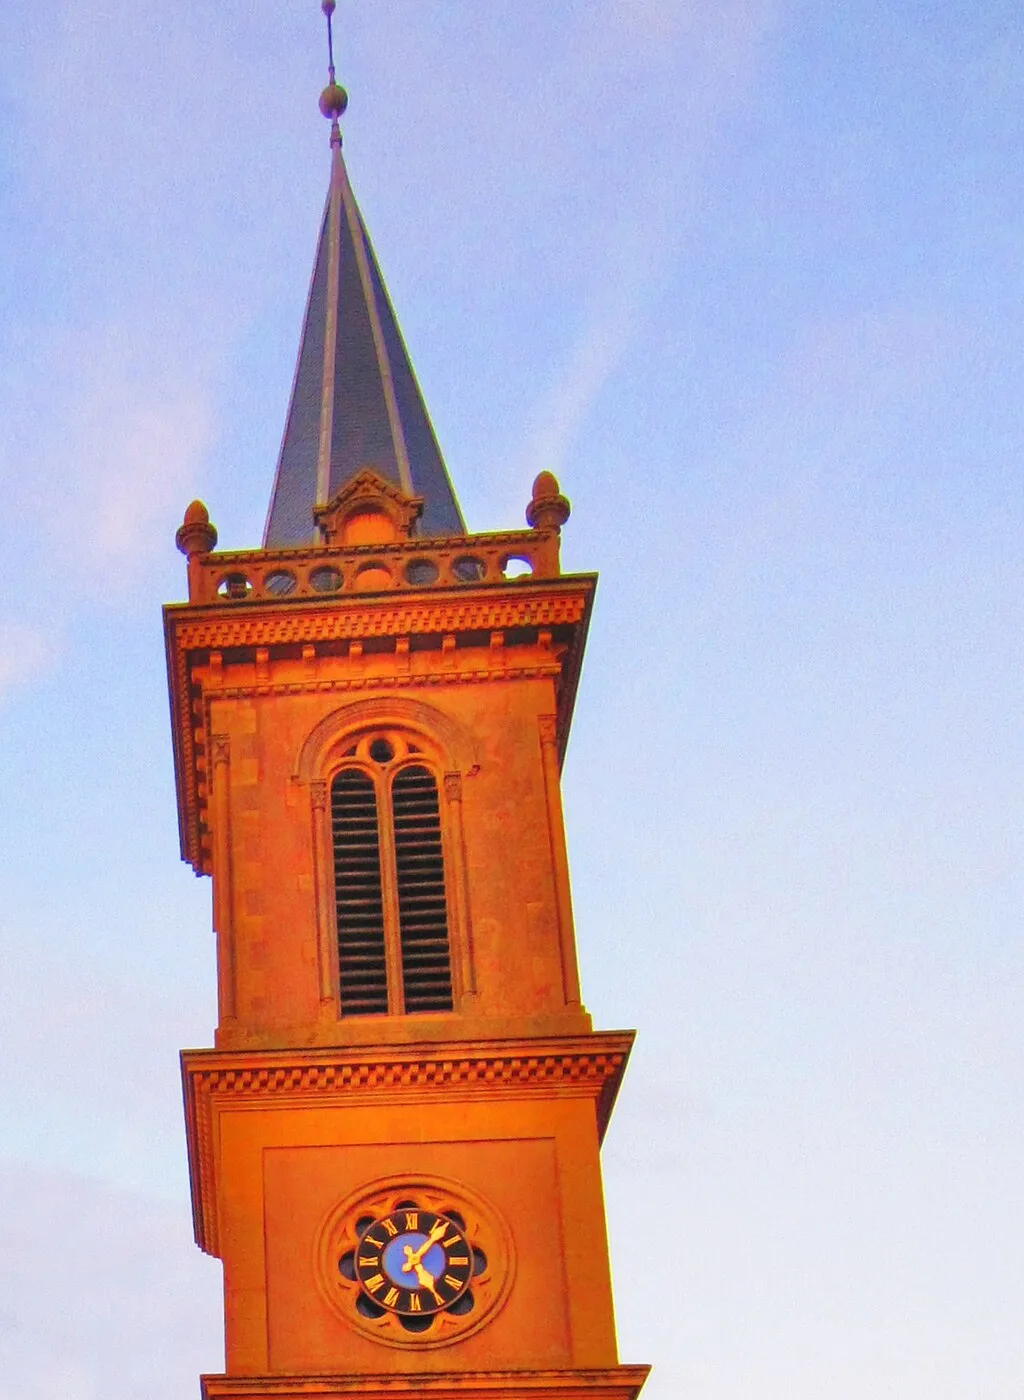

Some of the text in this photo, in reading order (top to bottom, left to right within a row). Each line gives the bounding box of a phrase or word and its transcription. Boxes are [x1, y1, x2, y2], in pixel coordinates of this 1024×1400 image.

[381, 1218, 399, 1236] XI
[406, 1213, 418, 1230] XII
[365, 1235, 385, 1249] X
[443, 1234, 462, 1248] II
[359, 1256, 378, 1267] IX
[449, 1257, 468, 1266] III
[364, 1273, 385, 1293] VIII
[383, 1287, 400, 1307] VII
[410, 1293, 422, 1311] VI
